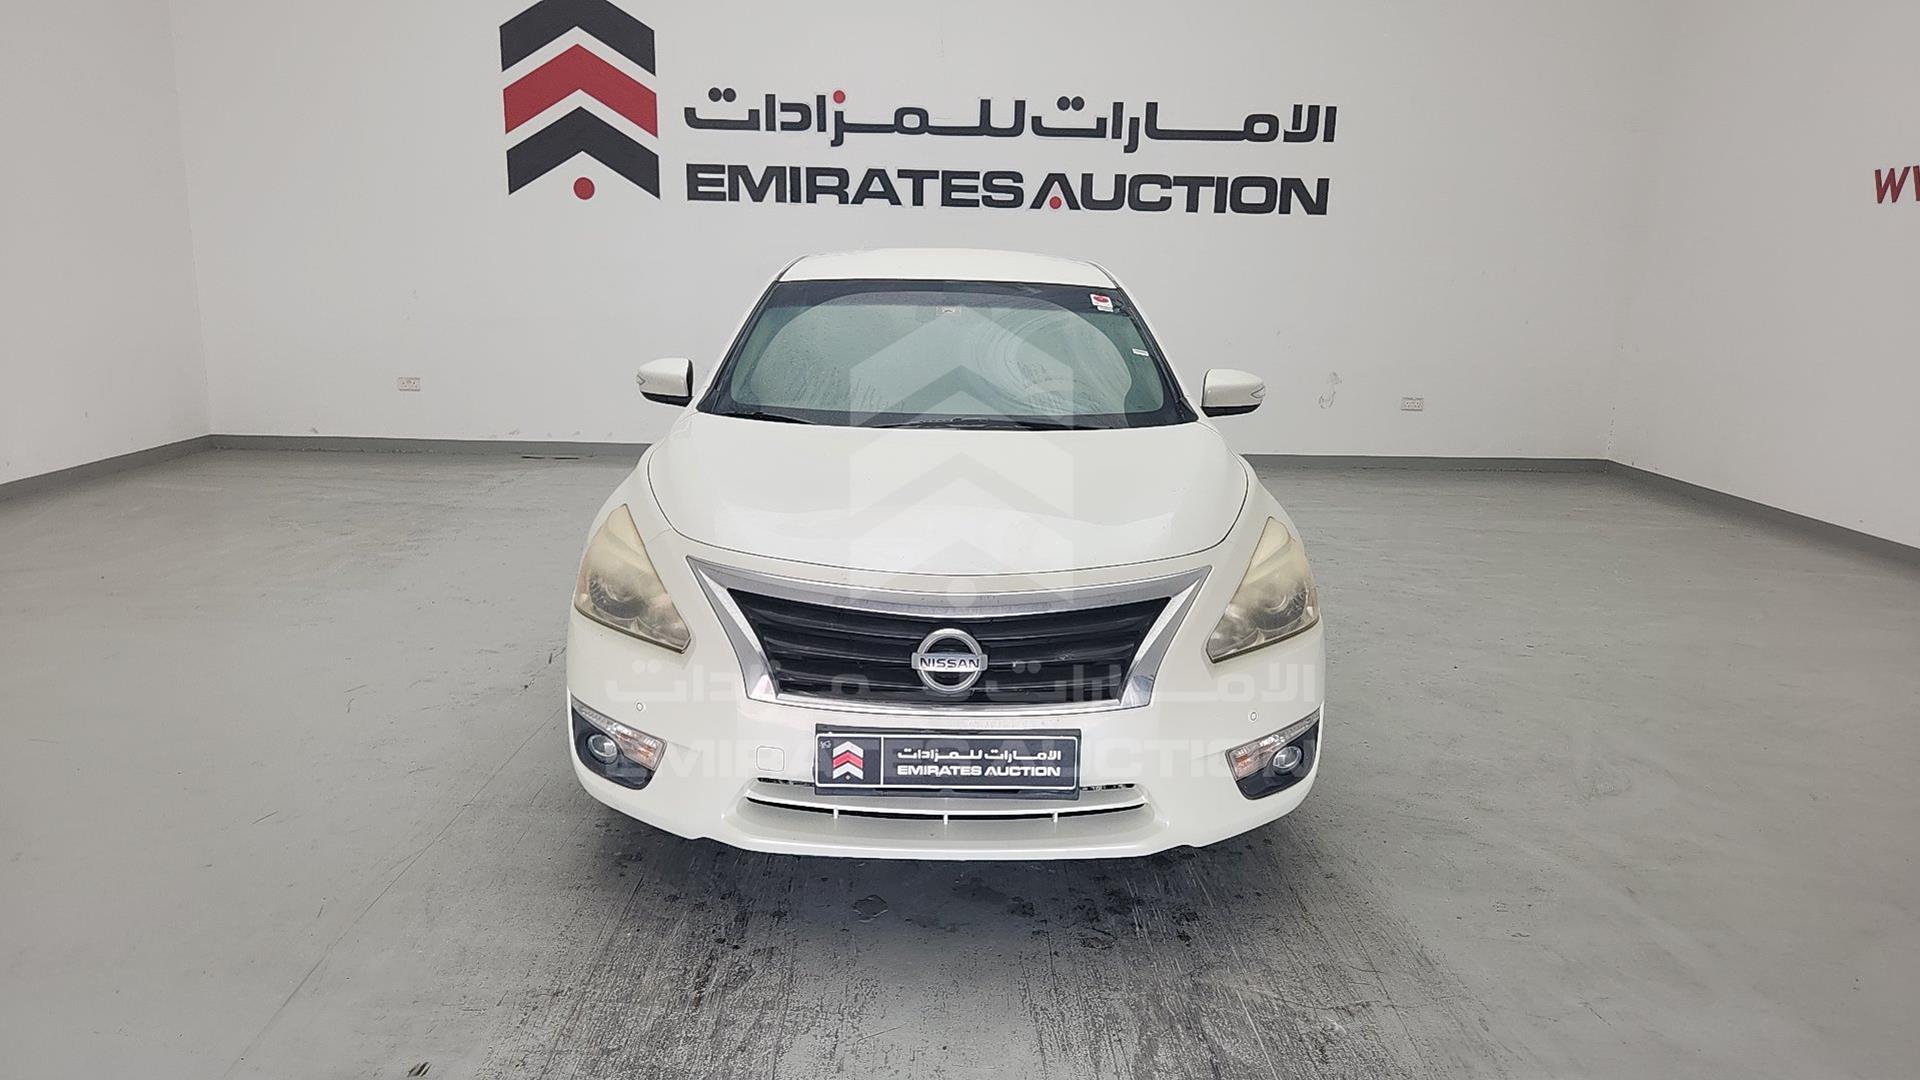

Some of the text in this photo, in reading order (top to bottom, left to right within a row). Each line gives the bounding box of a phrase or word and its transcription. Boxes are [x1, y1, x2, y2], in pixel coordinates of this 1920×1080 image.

[684, 87, 1337, 153] الامارات للمزادات
[686, 163, 1330, 215] EMIRATES AUCTION
[1874, 165, 1920, 204] W
[920, 657, 980, 668] NISSAN
[897, 765, 1061, 777] EMIRATES AUCTION
